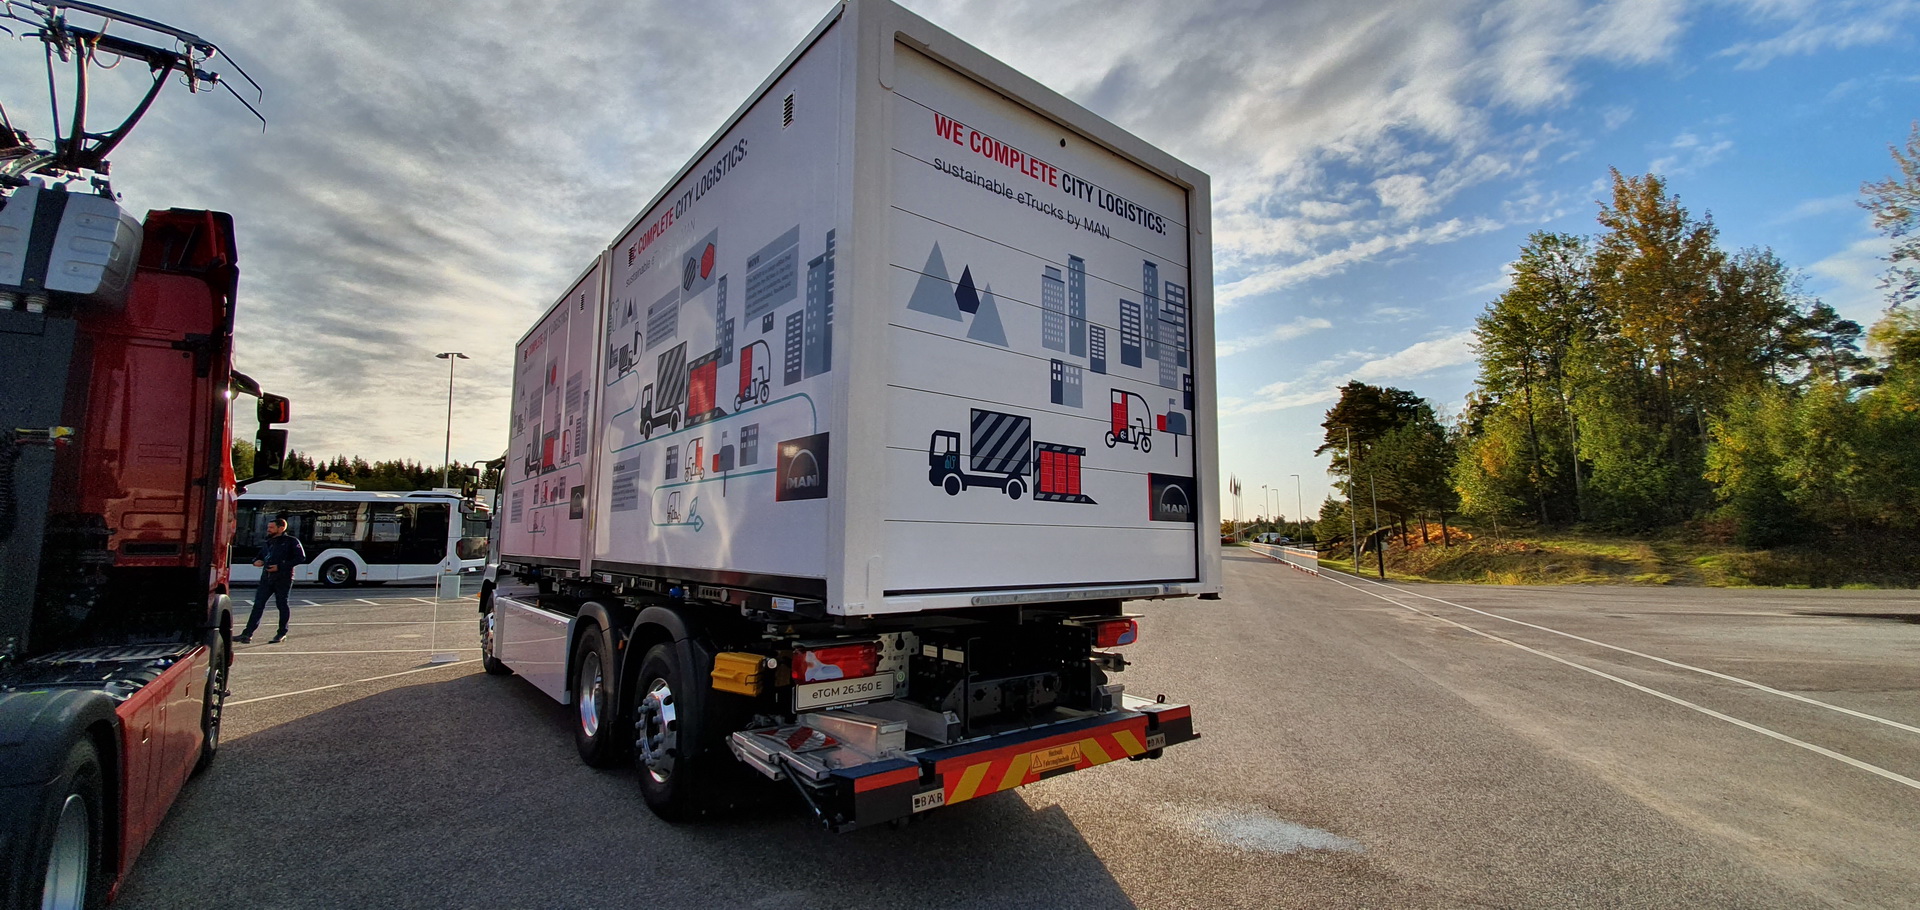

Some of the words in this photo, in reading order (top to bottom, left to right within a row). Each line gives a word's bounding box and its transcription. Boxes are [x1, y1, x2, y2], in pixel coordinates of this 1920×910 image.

[934, 113, 964, 147] WE
[969, 131, 1058, 188] COMPLETE
[1062, 173, 1094, 203] CITY
[1098, 189, 1166, 236] LOGISTICS:
[637, 206, 674, 255] COMPLETE
[675, 187, 694, 220] CITY
[695, 138, 748, 202] LOGISTICS:
[934, 158, 1013, 199] sustainable
[1017, 192, 1064, 221] eTrucks
[1067, 210, 1081, 230] by
[1084, 217, 1110, 239] MAN
[787, 474, 817, 489] MAN
[1161, 503, 1187, 513] MAN
[812, 687, 840, 699] eTGM
[842, 682, 874, 695] 26.360
[876, 681, 882, 690] E
[920, 792, 943, 807] BÄR
